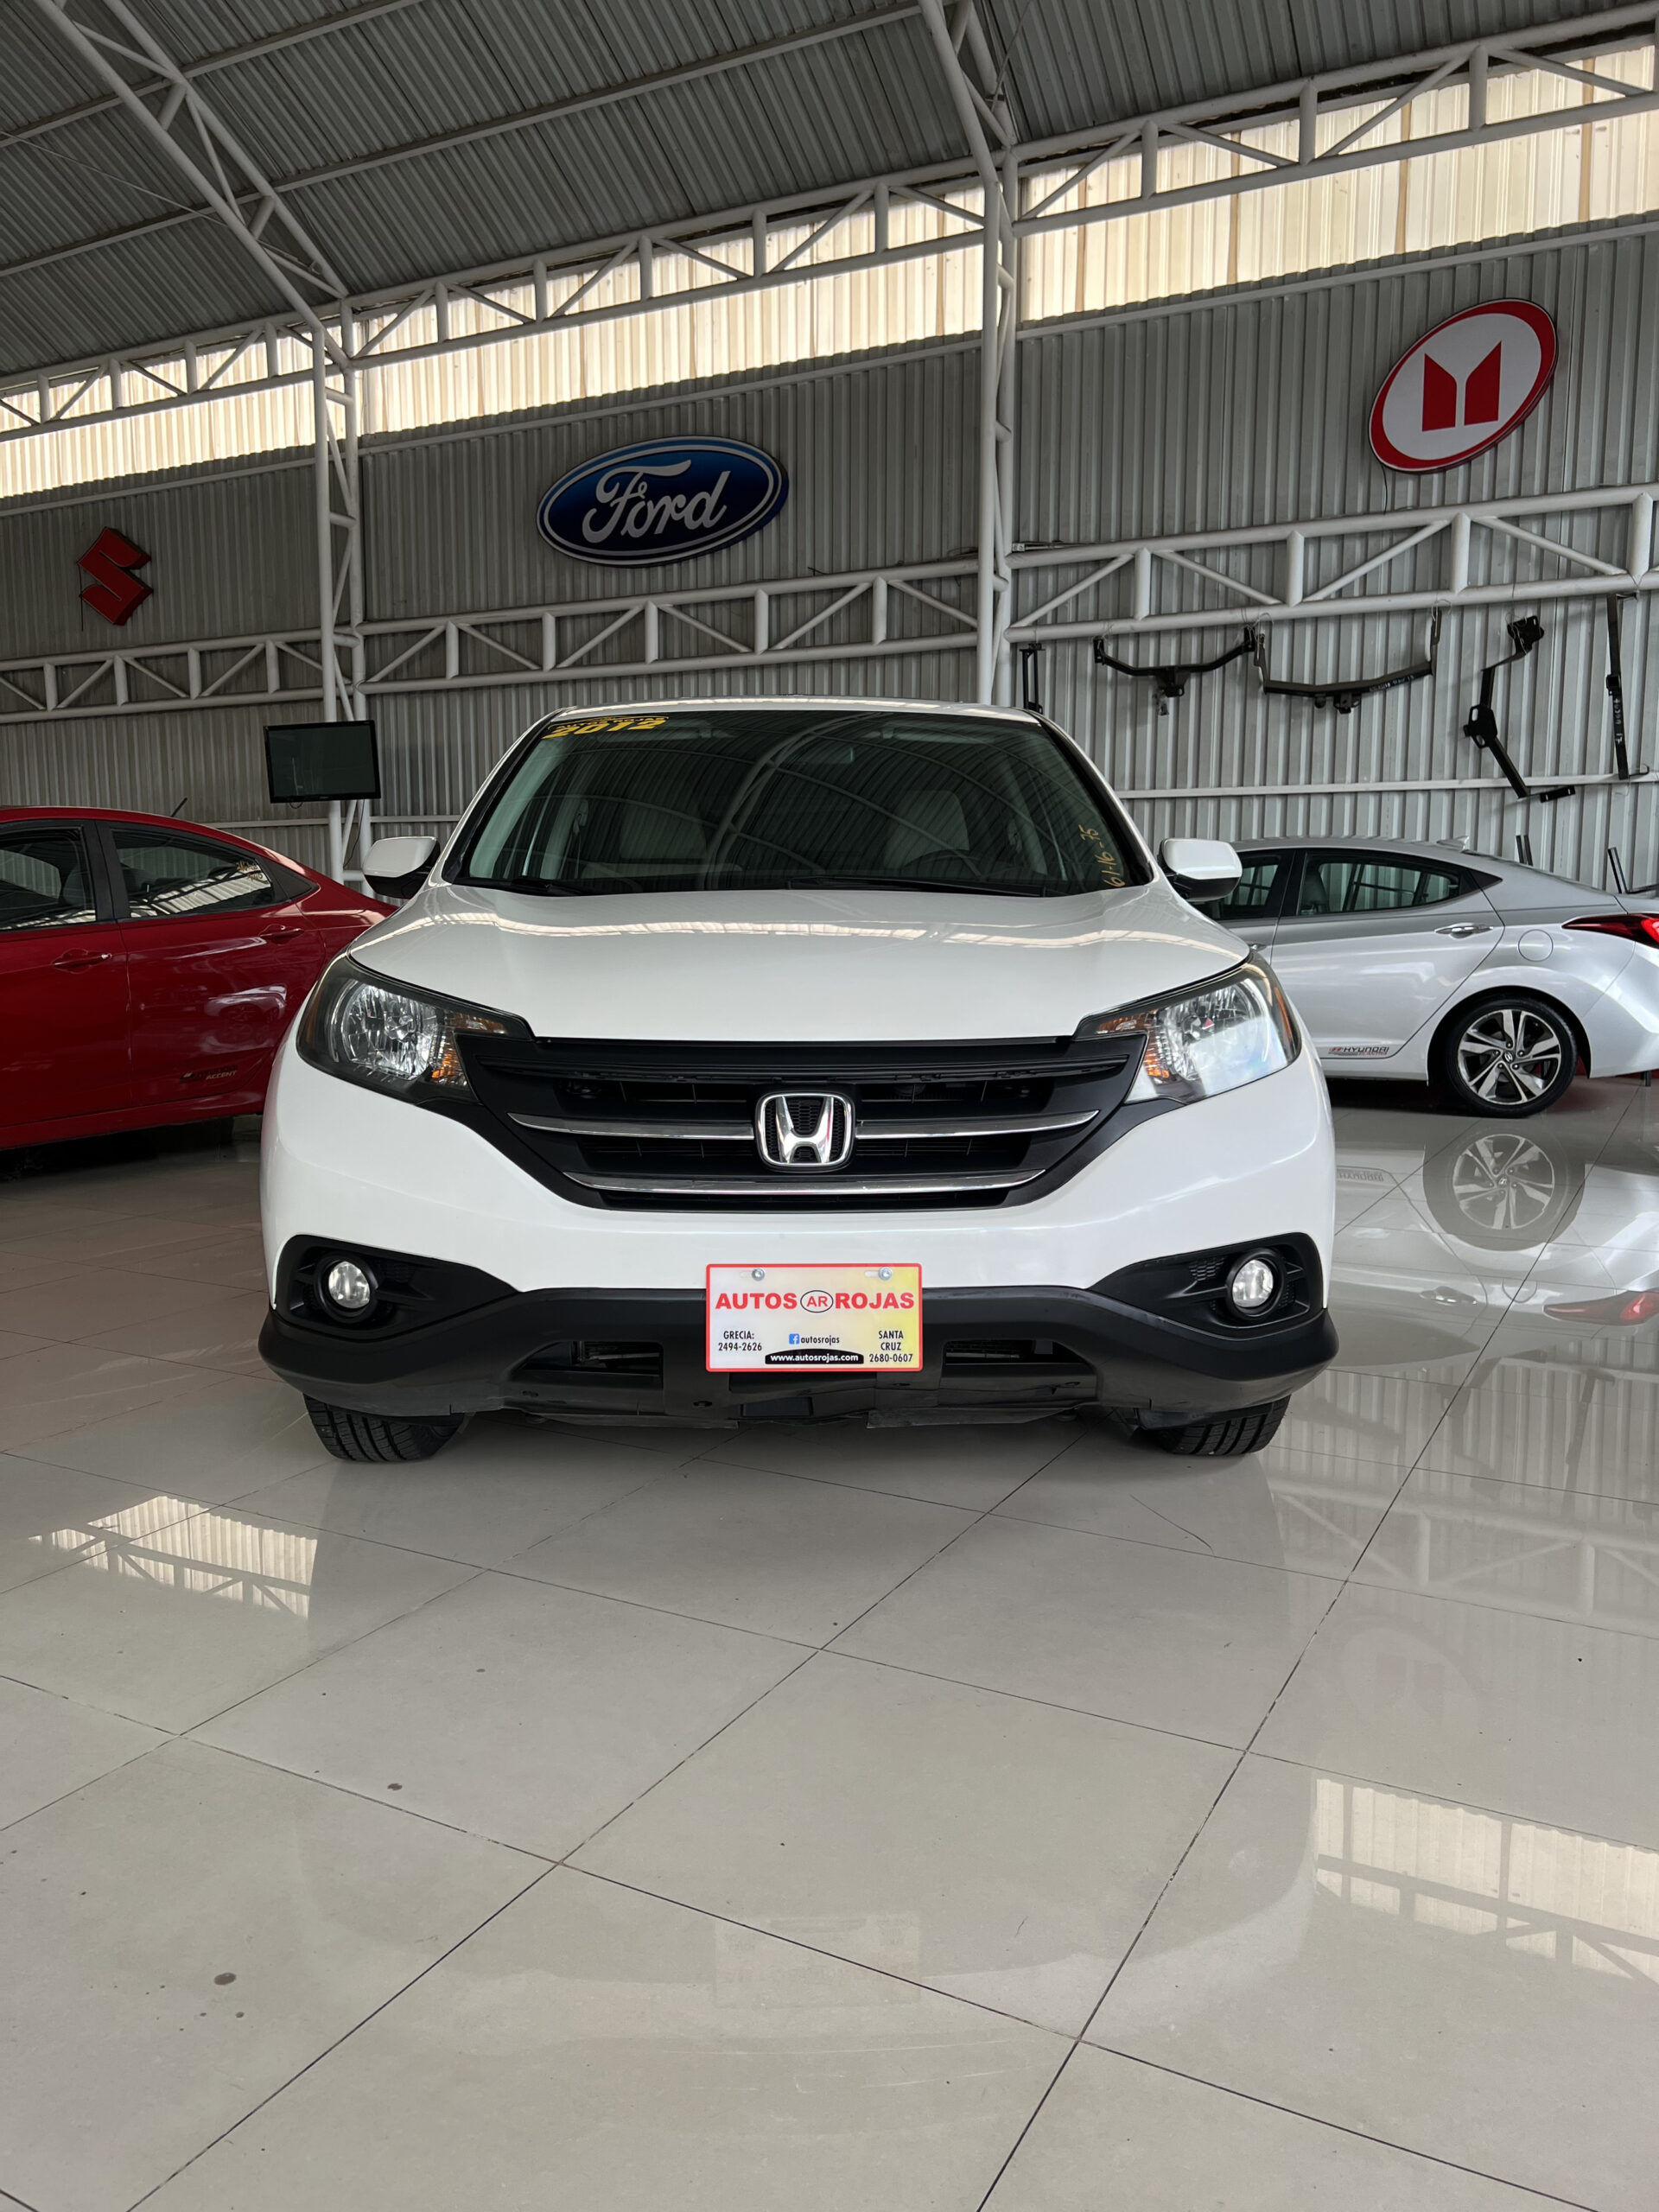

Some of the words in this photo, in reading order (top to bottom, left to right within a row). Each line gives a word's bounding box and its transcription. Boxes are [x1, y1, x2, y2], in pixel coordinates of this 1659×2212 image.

[582, 459, 731, 543] Ford
[541, 720, 666, 740] 2012
[205, 1070, 238, 1081] ACCENT
[715, 1292, 798, 1310] AUTOS
[806, 1295, 828, 1307] AR
[835, 1292, 915, 1310] ROJAS
[723, 1330, 754, 1340] GRECIA:
[878, 1330, 904, 1339] SANTA
[800, 1335, 840, 1346] autosrojas
[718, 1342, 762, 1351] 2494-2626
[880, 1342, 901, 1351] CRUZ
[770, 1352, 859, 1363] www.autosrojas.com
[869, 1353, 913, 1363] 2680-0607
